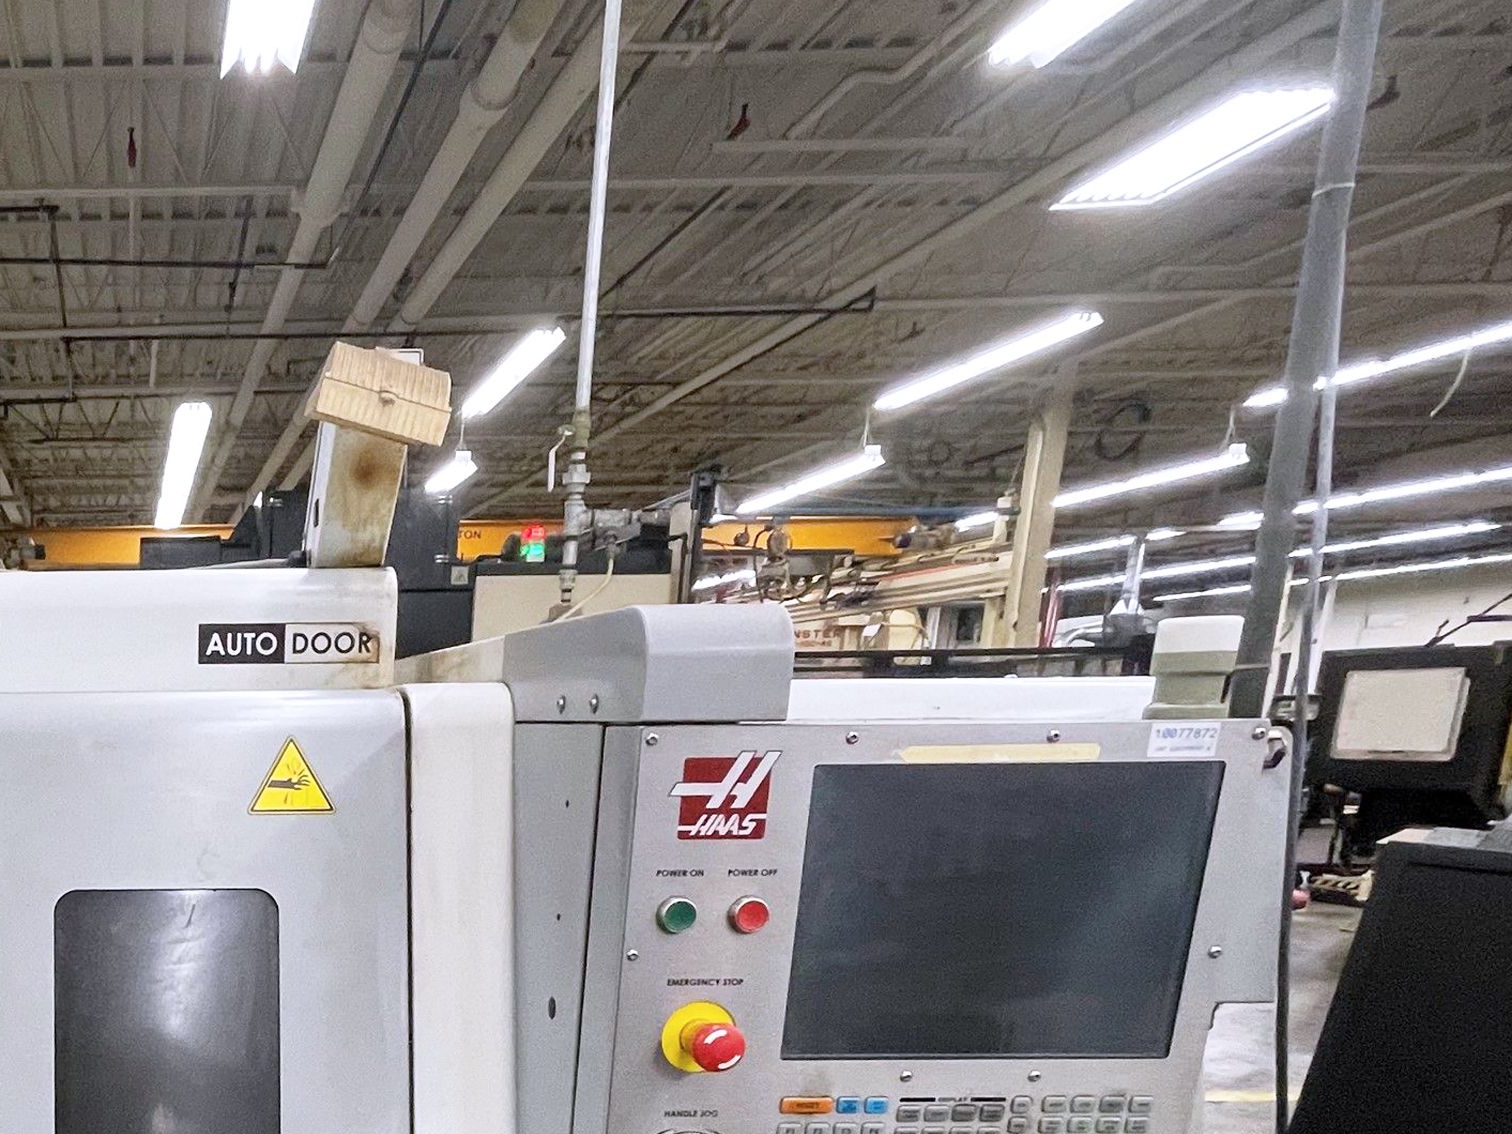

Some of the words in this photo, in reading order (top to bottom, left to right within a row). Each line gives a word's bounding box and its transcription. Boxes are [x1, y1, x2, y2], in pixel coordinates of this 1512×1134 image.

[205, 631, 278, 656] AUTO
[292, 631, 372, 655] DOOR
[677, 813, 767, 836] HAAS
[656, 869, 688, 877] POWER
[689, 869, 704, 877] ON
[728, 868, 759, 877] POWER
[761, 868, 778, 876] OFF
